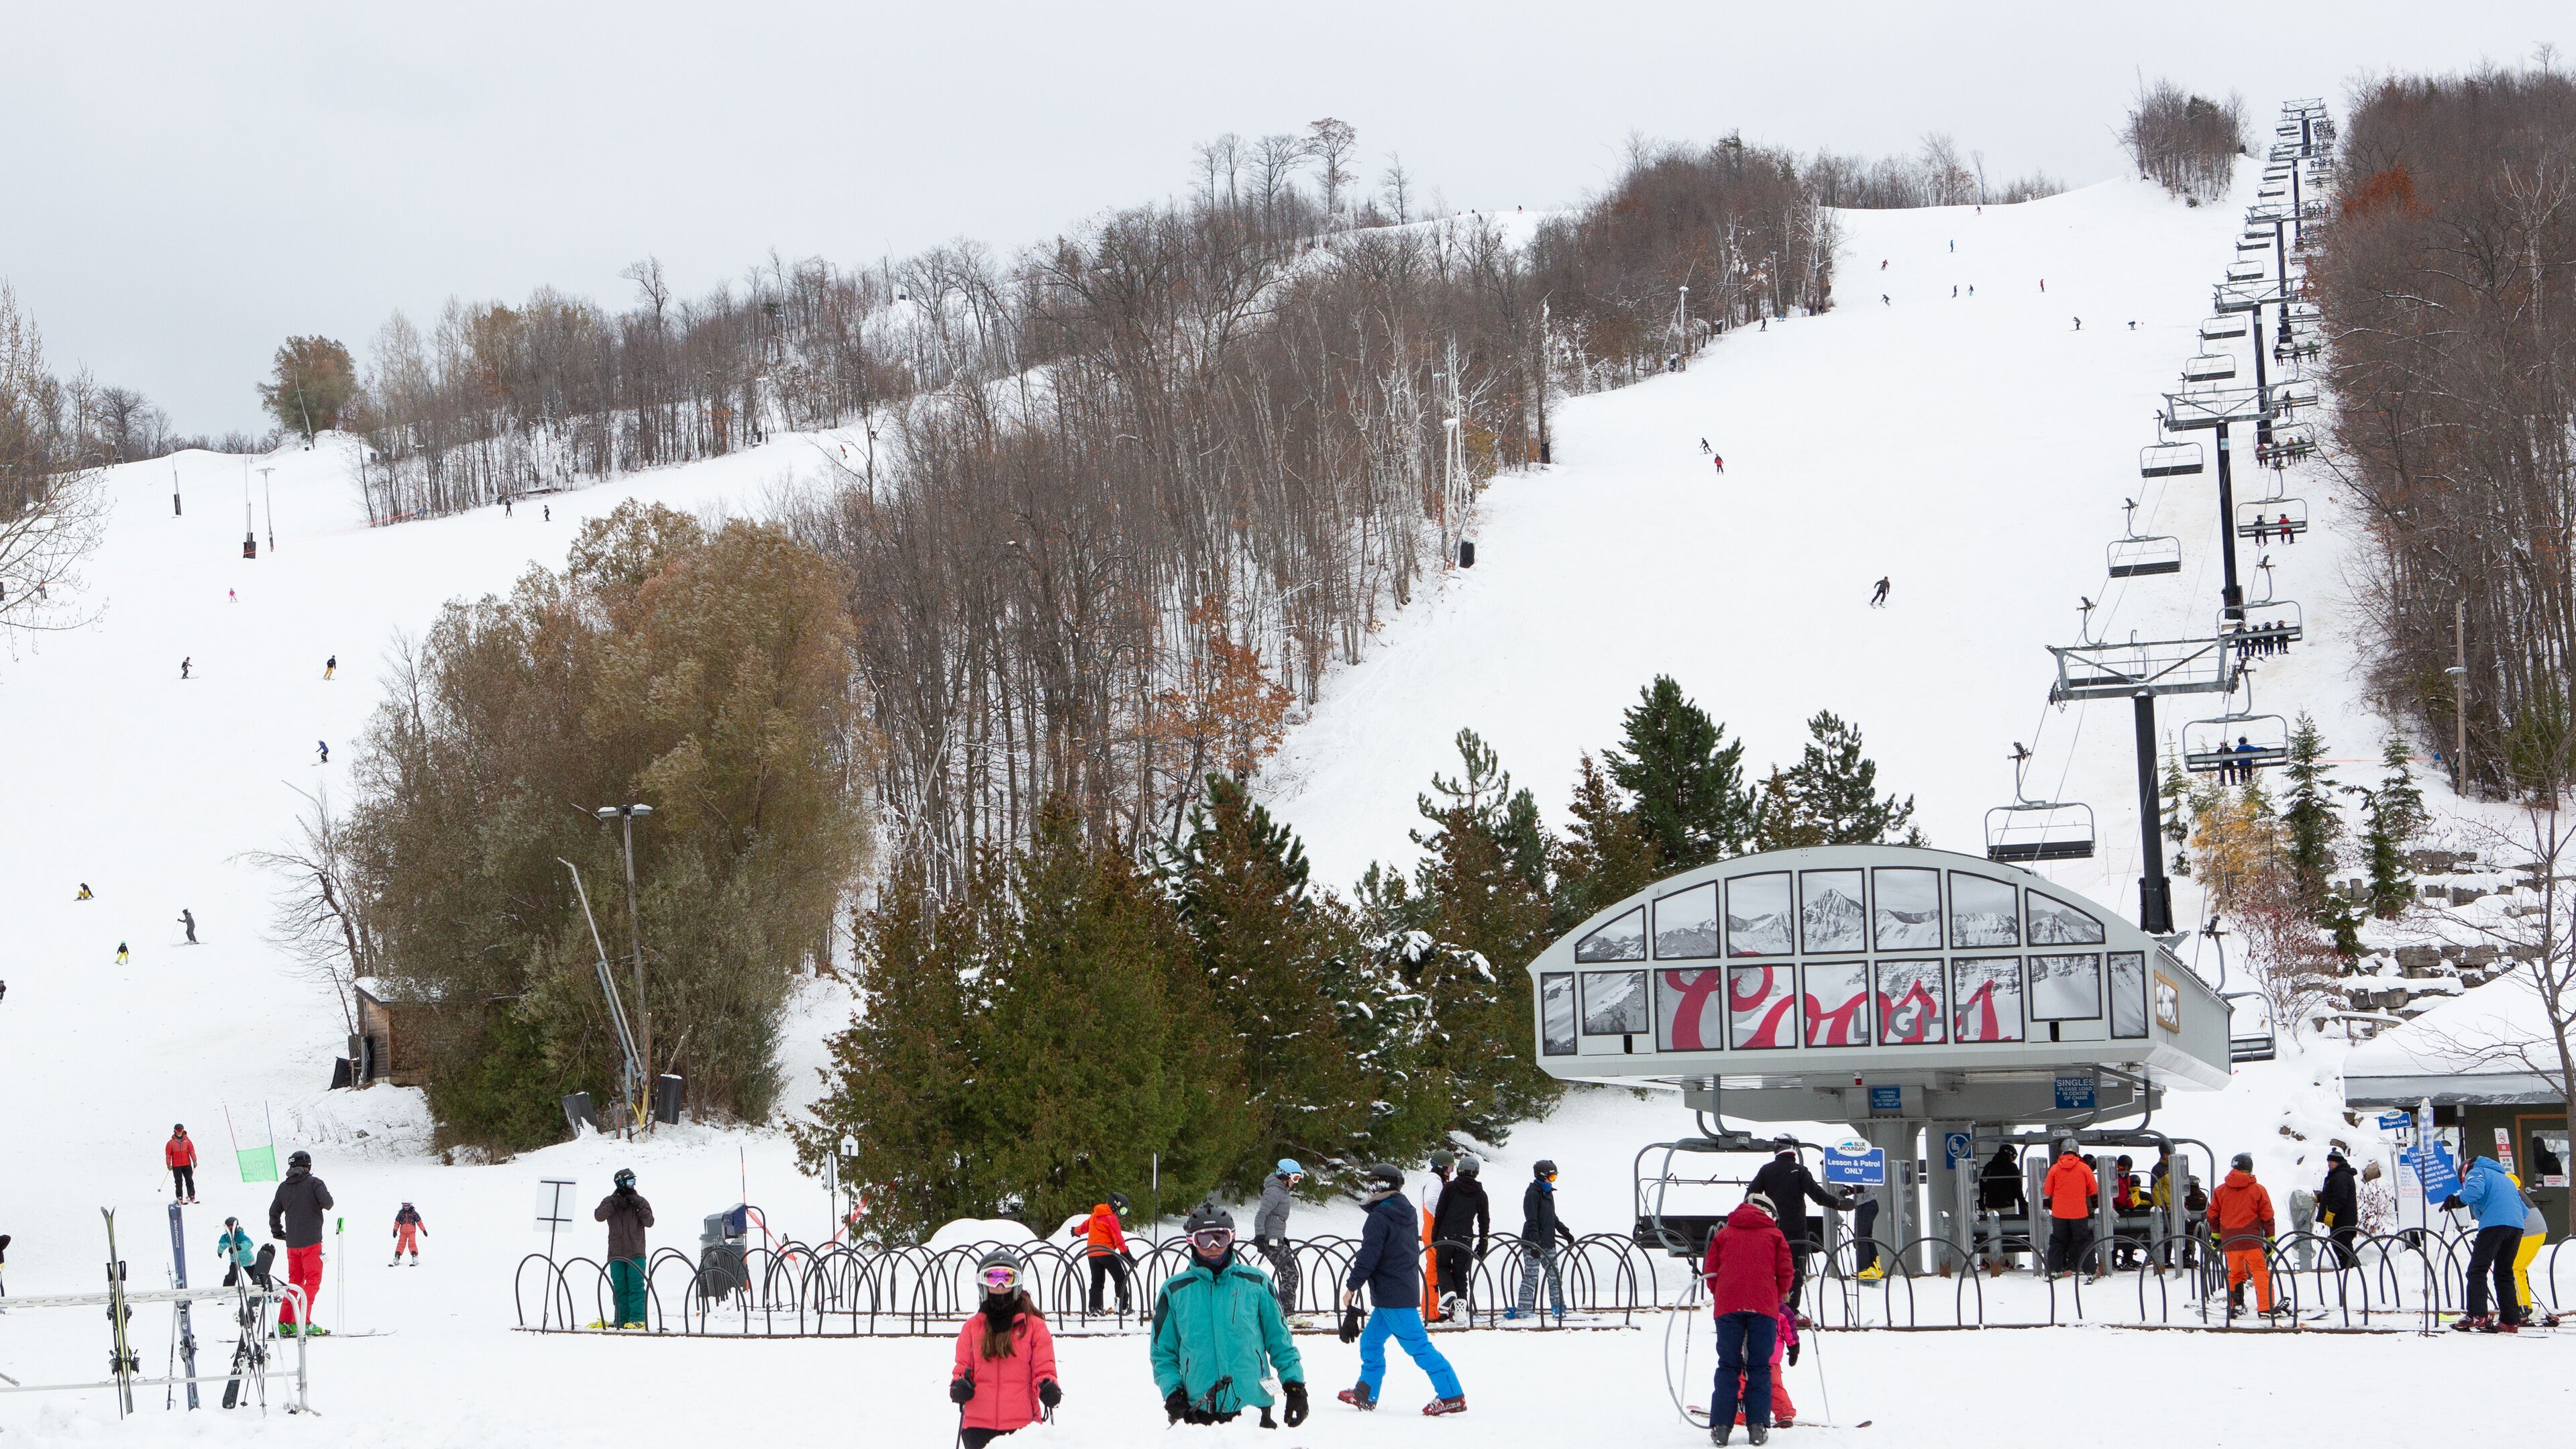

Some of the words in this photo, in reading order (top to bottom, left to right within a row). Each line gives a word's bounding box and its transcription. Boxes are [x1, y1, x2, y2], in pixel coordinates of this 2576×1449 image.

[1665, 951, 2012, 1051] Coors
[1853, 1004, 1975, 1039] LIGHT
[2056, 1079, 2094, 1087] SINGLES
